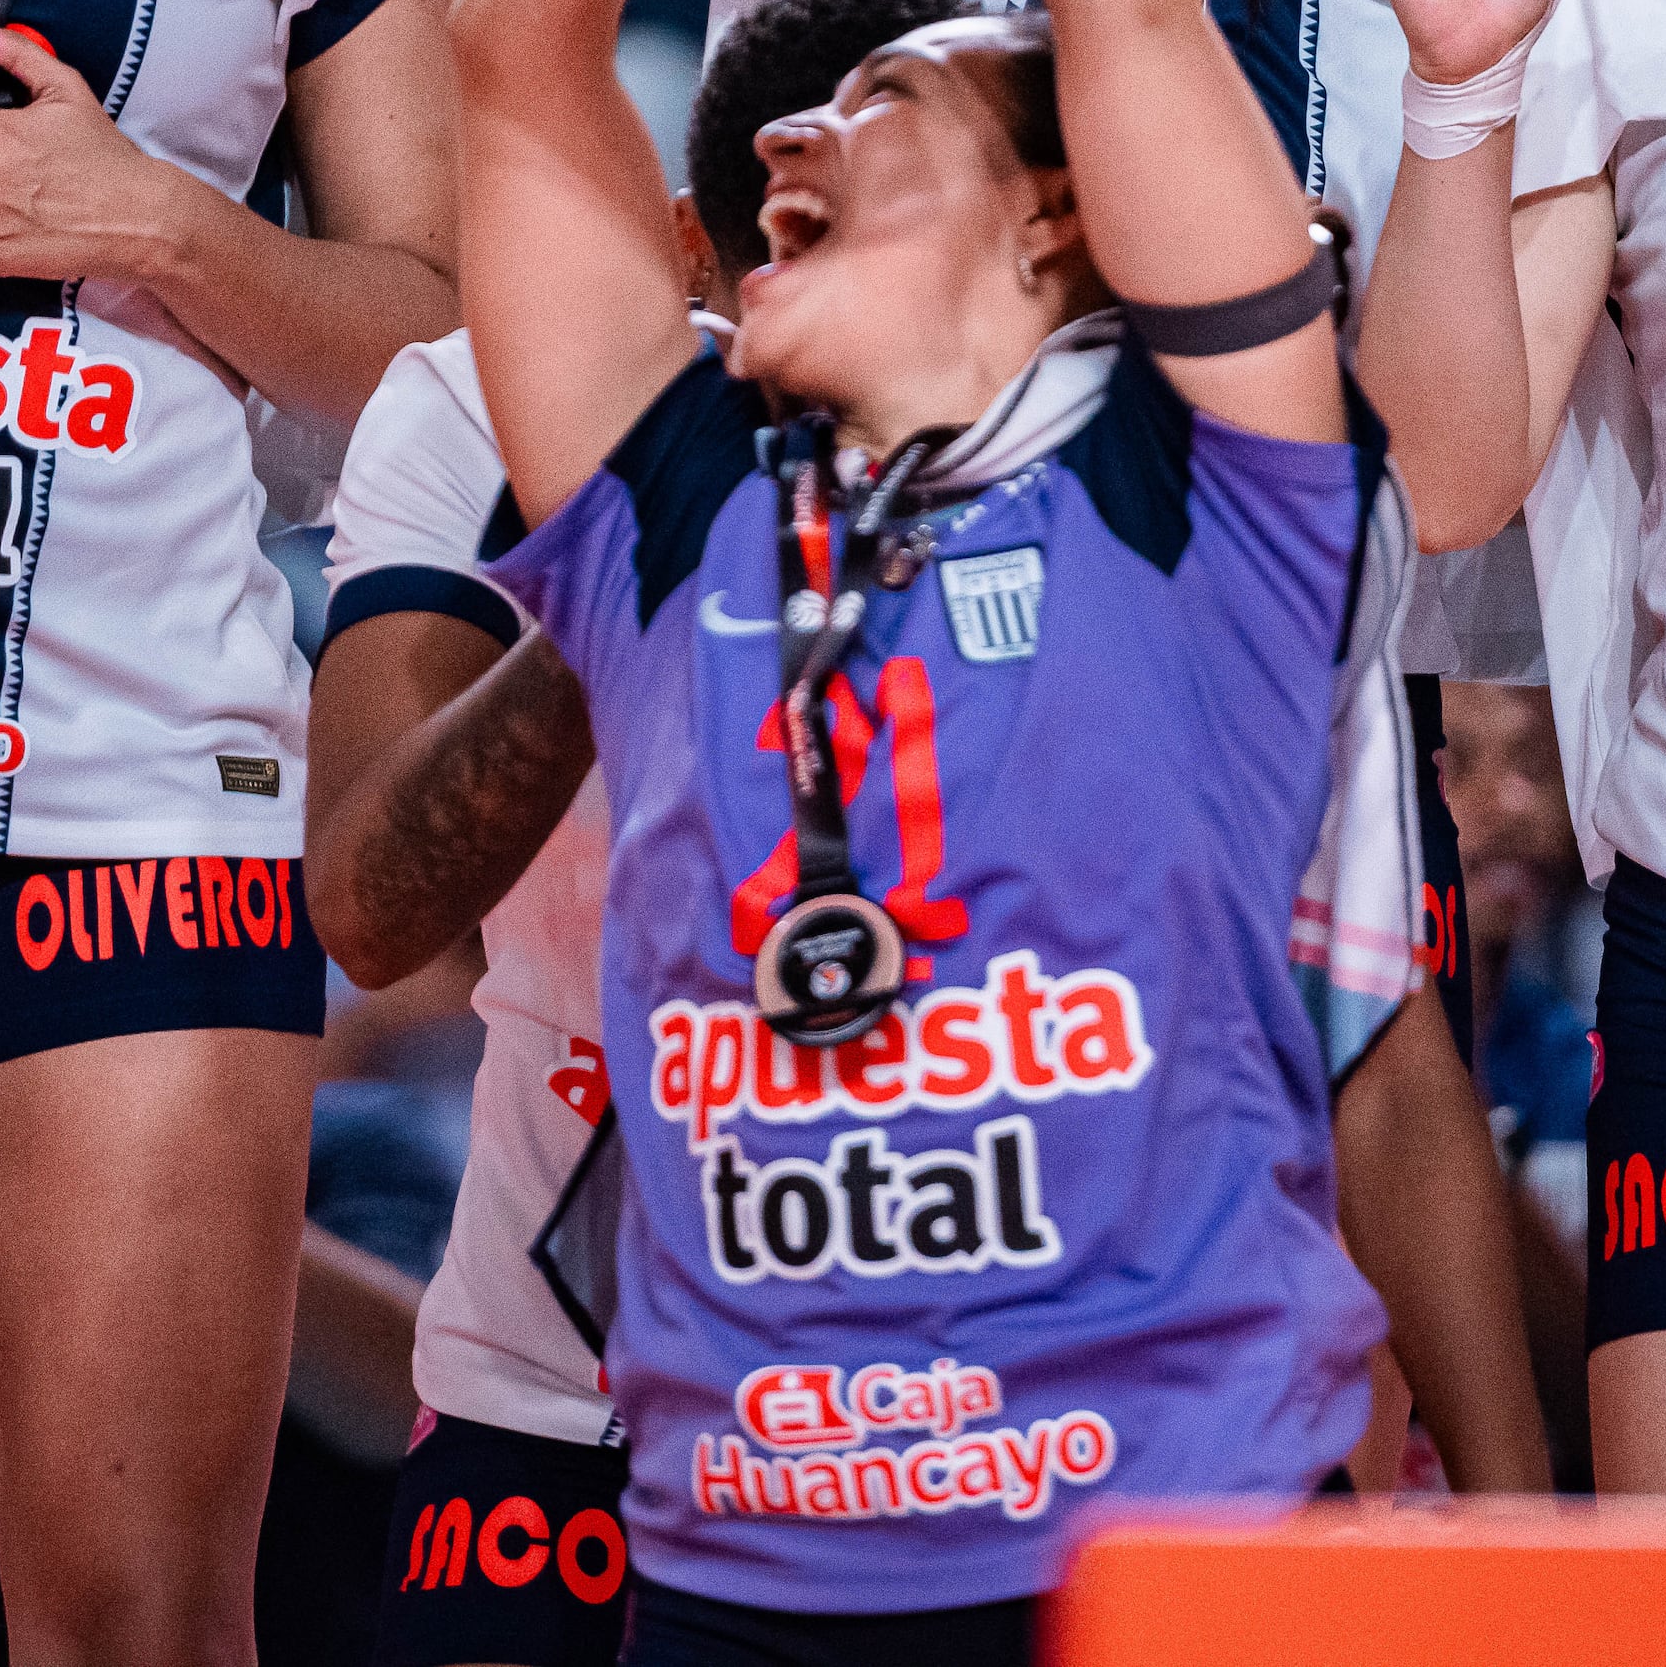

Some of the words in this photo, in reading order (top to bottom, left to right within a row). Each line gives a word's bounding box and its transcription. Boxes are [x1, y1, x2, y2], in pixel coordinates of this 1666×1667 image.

[15, 855, 293, 971] OLIVEROS
[659, 963, 1140, 1141] apuesta
[716, 1130, 1048, 1272] total
[855, 1359, 999, 1439] Caja
[695, 1413, 1111, 1517] Huancayo
[398, 1495, 628, 1605] SACO
